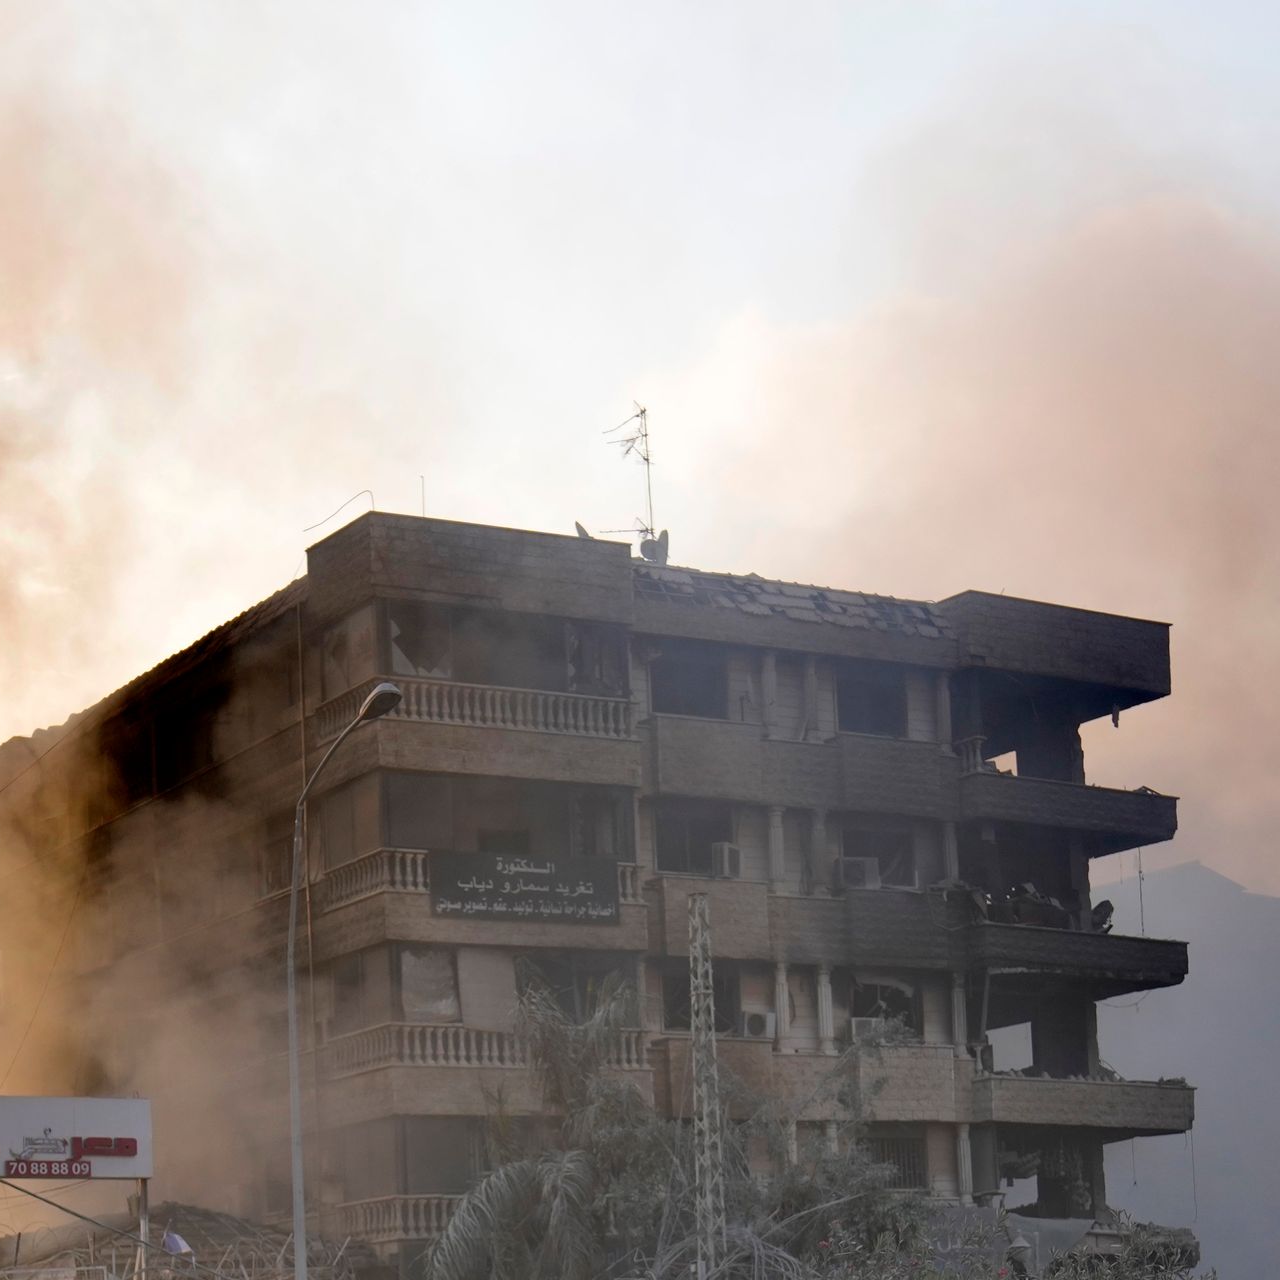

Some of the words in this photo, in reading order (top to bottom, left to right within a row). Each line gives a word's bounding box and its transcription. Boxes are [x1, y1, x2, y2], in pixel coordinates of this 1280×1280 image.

[457, 876, 494, 891] دياب
[9, 1161, 27, 1176] 70
[30, 1161, 49, 1176] 88
[51, 1161, 69, 1176] 88
[71, 1161, 90, 1176] 09
